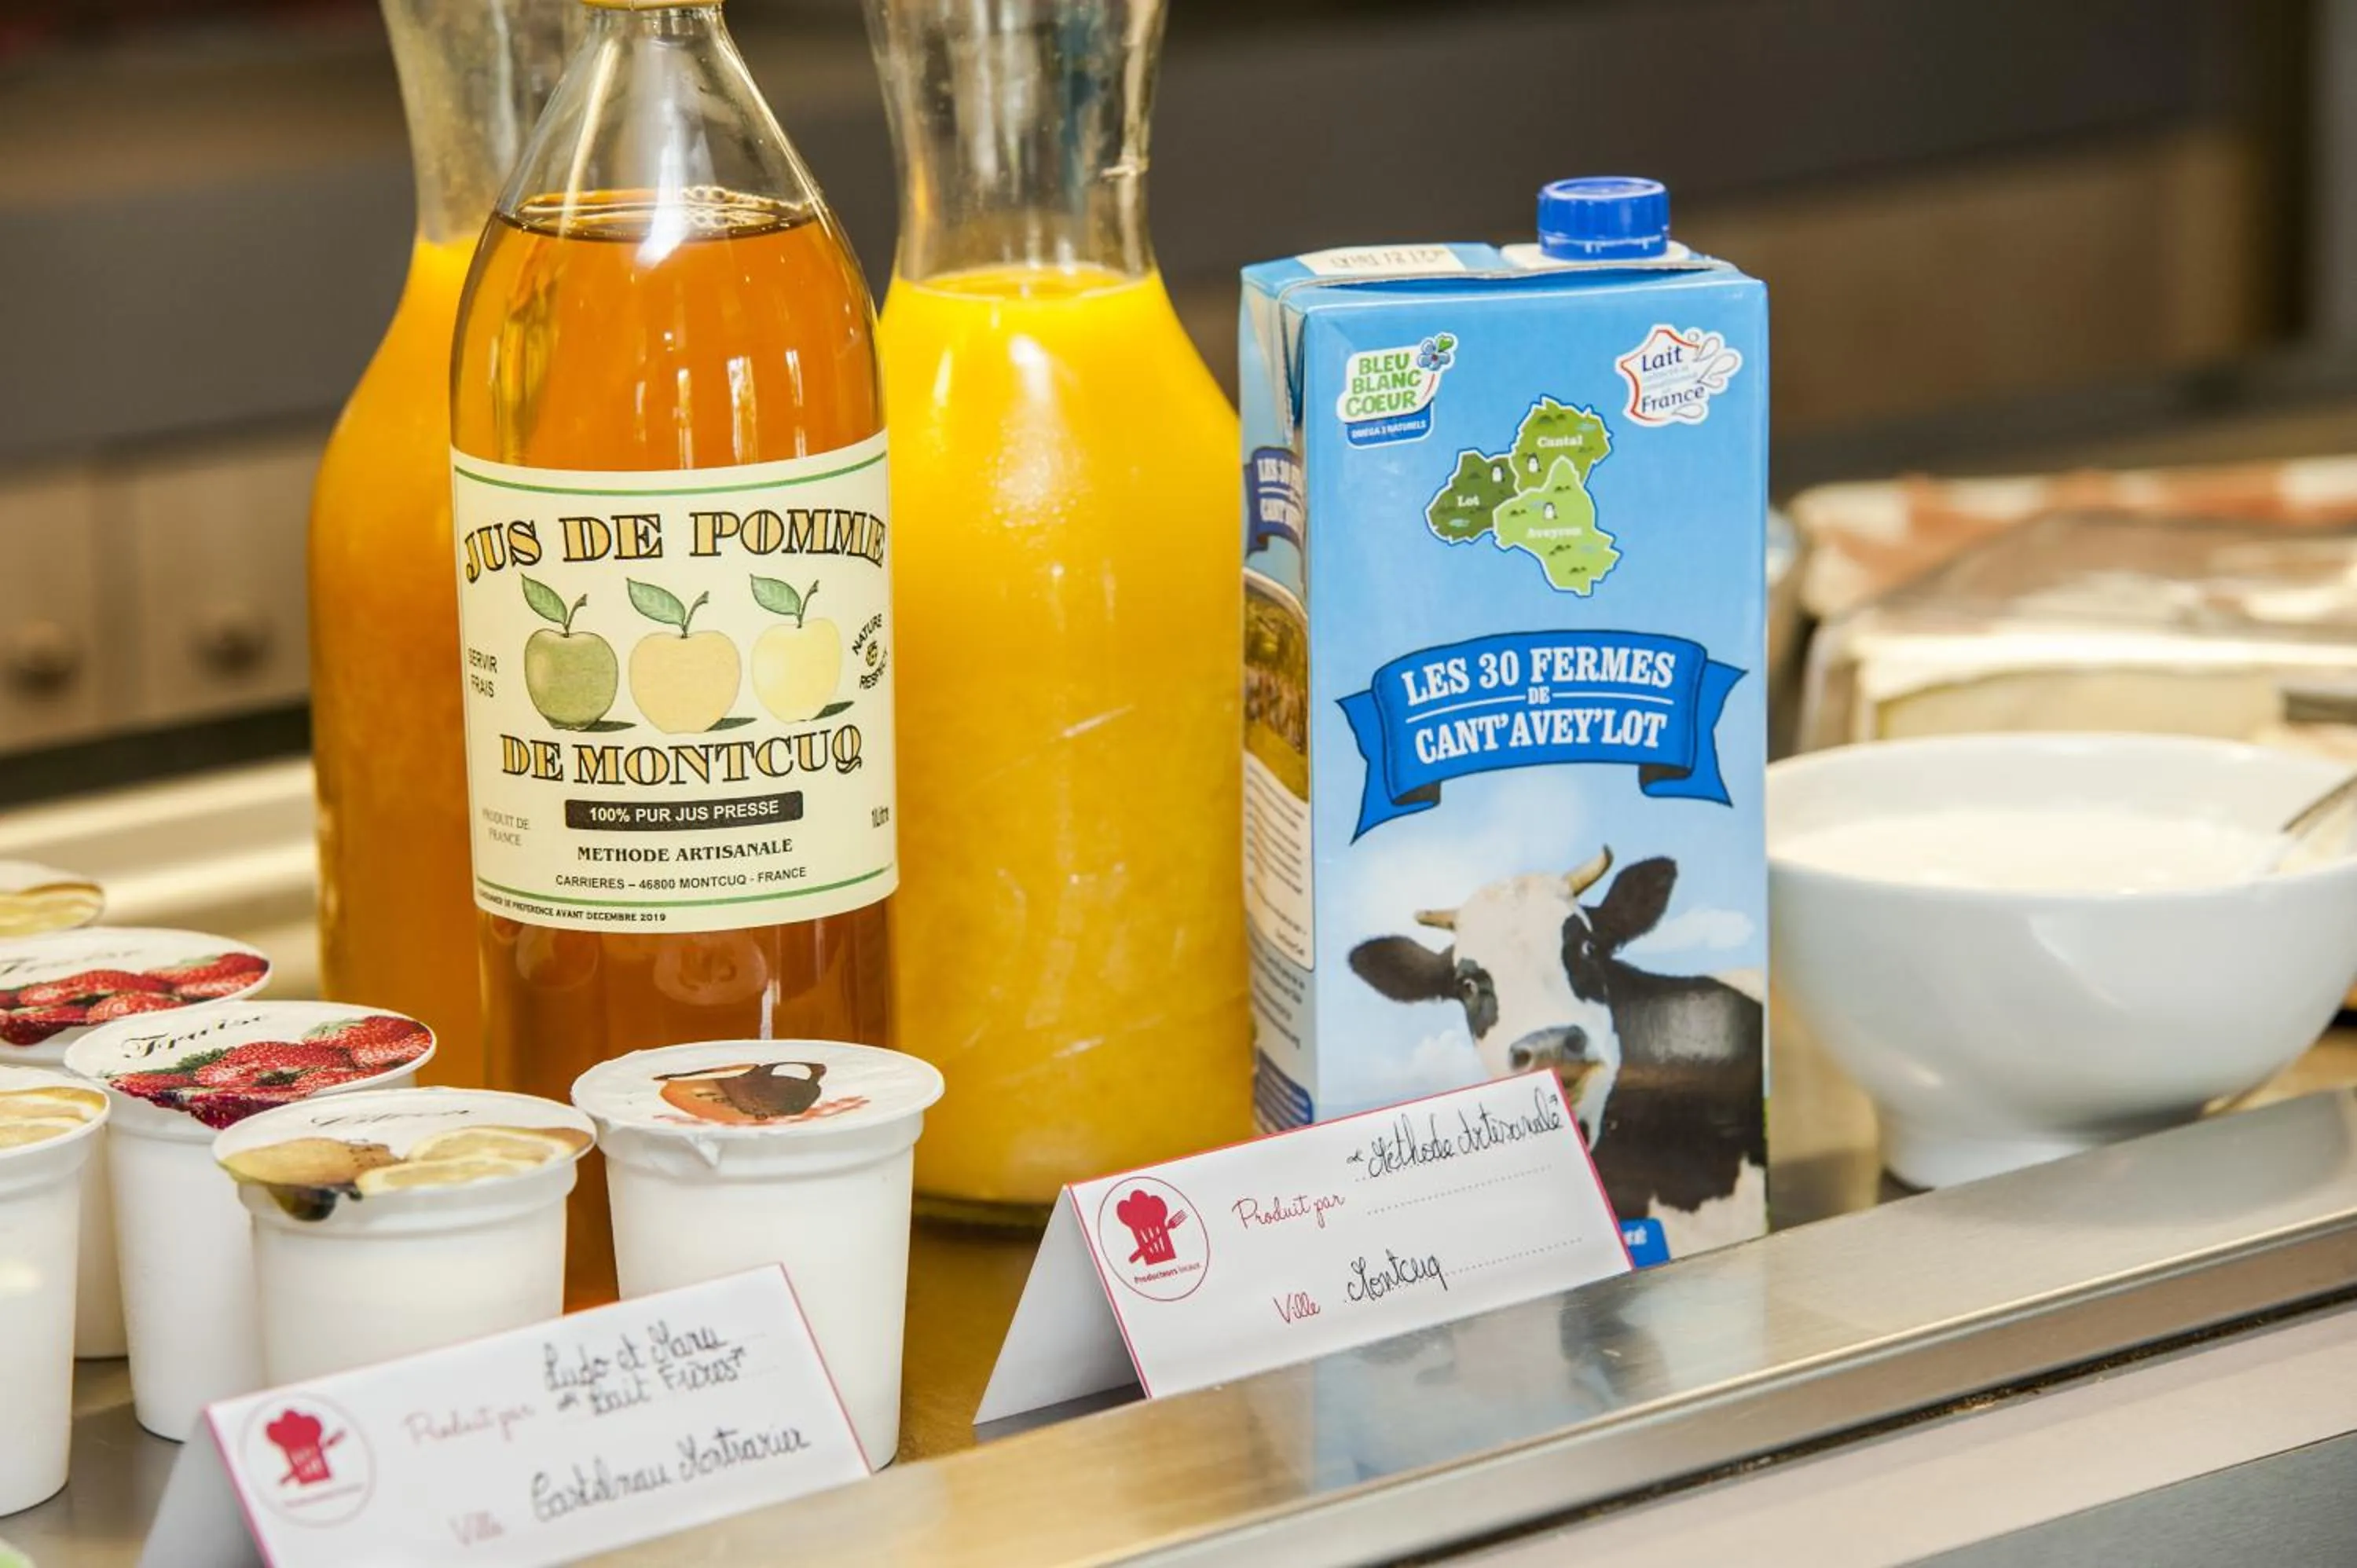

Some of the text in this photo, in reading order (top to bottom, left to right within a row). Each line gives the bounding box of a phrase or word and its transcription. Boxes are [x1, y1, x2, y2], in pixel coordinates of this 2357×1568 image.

[1358, 352, 1410, 376] BLEU
[1642, 346, 1683, 372] Lait
[1352, 369, 1421, 394] BLANC
[1345, 390, 1417, 417] COEUR
[1642, 387, 1705, 413] France
[1536, 435, 1584, 449] Cantal
[1457, 494, 1480, 507] Lot
[1527, 526, 1582, 540] Aveyron
[464, 508, 887, 584] JUS DE POMME
[852, 613, 882, 656] NATURE
[467, 648, 497, 673] SERVIR
[471, 674, 494, 698] FRAIS
[1401, 646, 1677, 706] LES 30 FERMES
[1527, 686, 1551, 705] DE
[500, 724, 863, 786] DE MONTCUQ
[516, 816, 530, 830] DE
[589, 799, 779, 823] 100% PUR JUS PRESSE
[488, 826, 522, 846] FRANCE
[577, 837, 794, 863] METHODE ARTISANALE
[555, 866, 807, 890] CARRIERES 46800 MONTCUQ FRANCE
[555, 908, 583, 920] AVANT
[586, 911, 636, 921] DECEMBRE
[640, 913, 666, 922] 2019
[1231, 1193, 1346, 1229] Produit par
[1273, 1291, 1321, 1324] Ville
